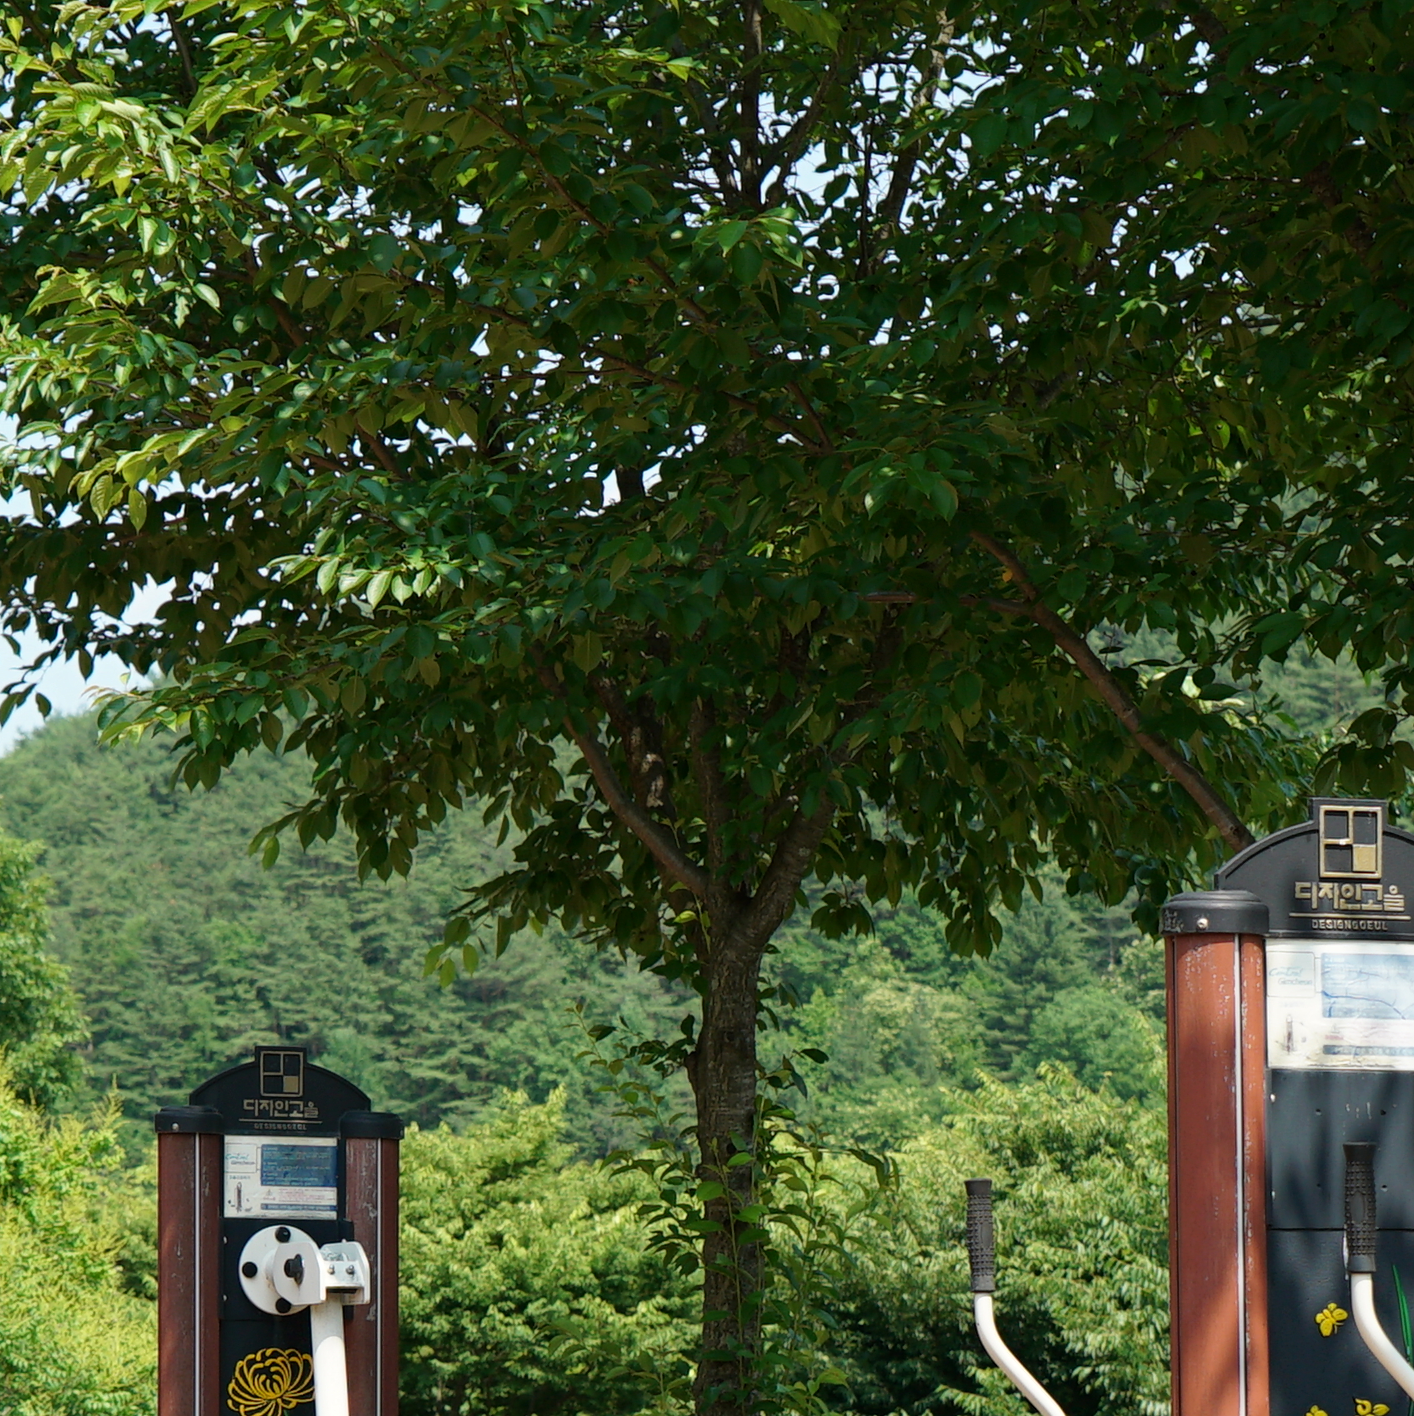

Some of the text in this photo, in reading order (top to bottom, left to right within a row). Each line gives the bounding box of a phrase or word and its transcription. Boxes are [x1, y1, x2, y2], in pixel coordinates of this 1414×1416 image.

[1294, 881, 1405, 912] 디자인고을
[1312, 919, 1388, 931] DESIGNGOEUL
[243, 1099, 319, 1118] 디자인고을
